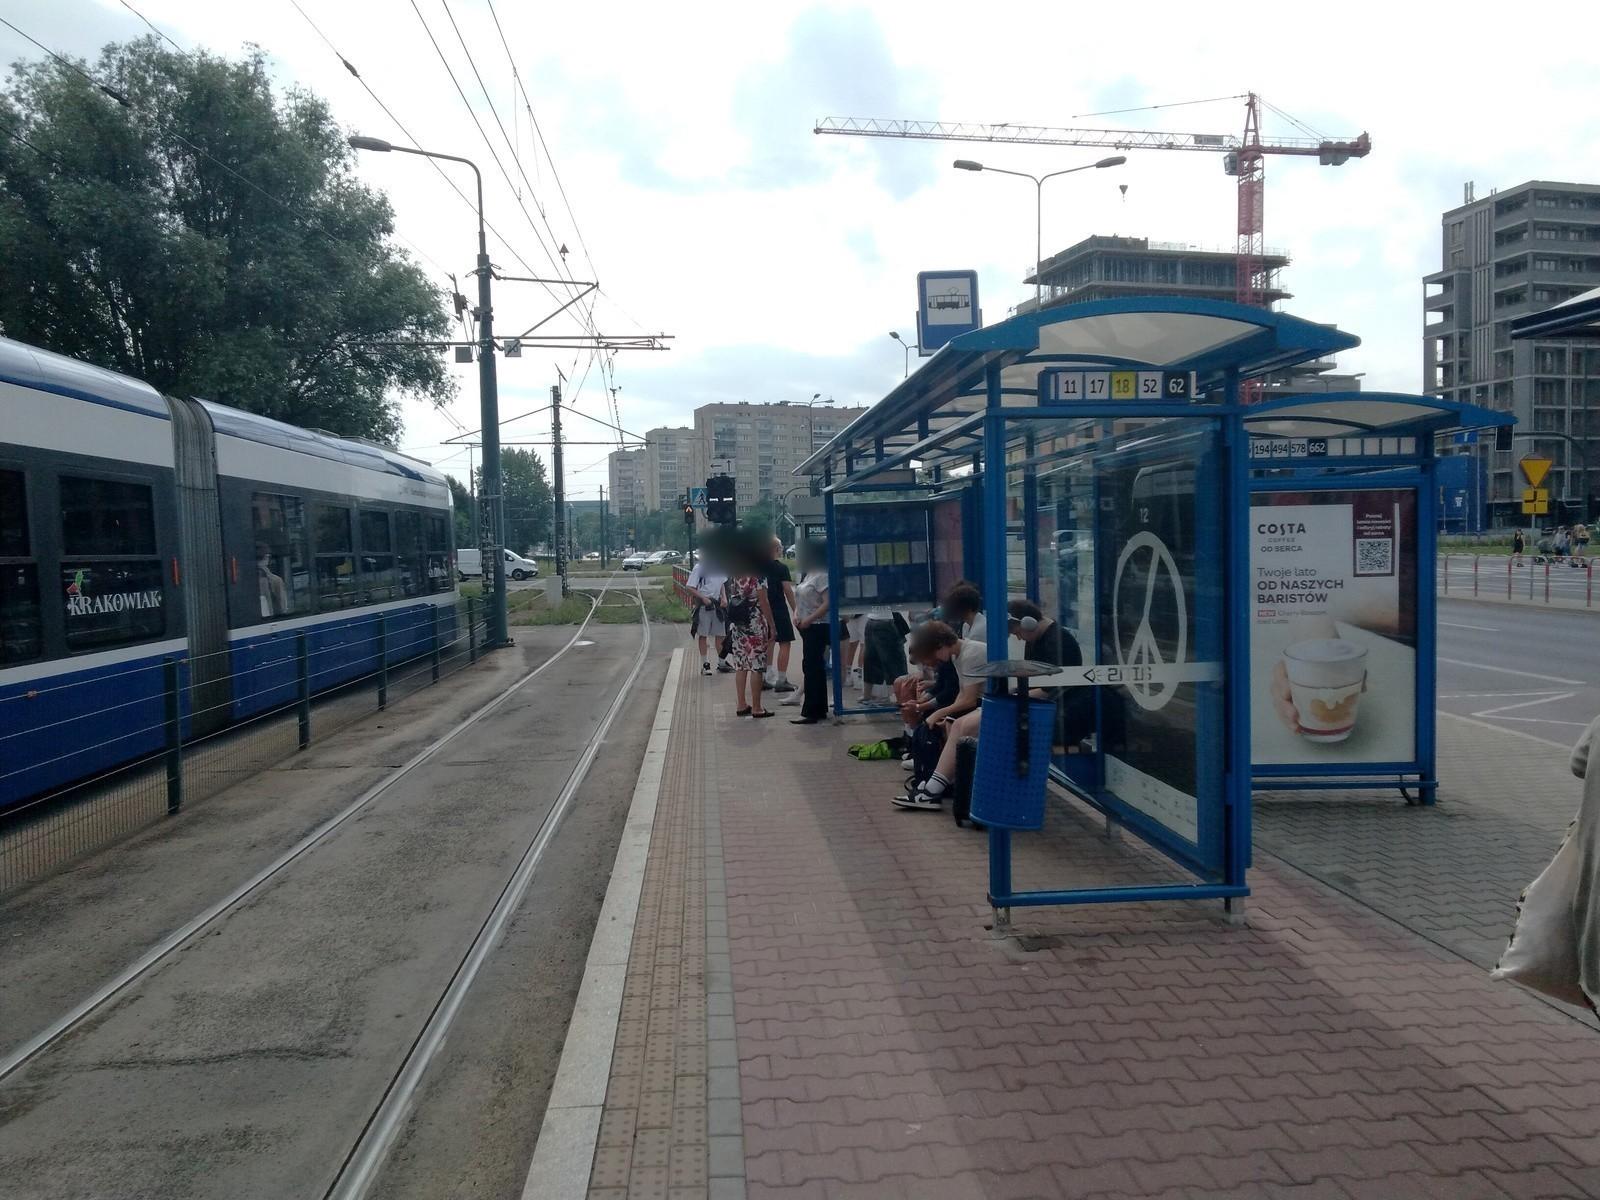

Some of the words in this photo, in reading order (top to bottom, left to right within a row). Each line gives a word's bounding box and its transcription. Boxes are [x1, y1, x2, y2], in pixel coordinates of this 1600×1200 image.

[1063, 379, 1077, 394] 11
[1090, 379, 1105, 394] 17
[1115, 379, 1130, 394] 18
[1143, 378, 1157, 393] 52
[1169, 378, 1184, 393] 62
[1254, 444, 1270, 455] 194
[1271, 443, 1288, 454] 494
[1291, 443, 1306, 454] 578
[1257, 523, 1306, 535] COSTA
[1274, 545, 1303, 553] SERCA
[1256, 567, 1292, 579] Twoje
[1294, 566, 1317, 577] lato
[1257, 580, 1278, 591] OD
[1280, 579, 1344, 590] NASZYCH
[69, 590, 161, 616] KRAKOWIAK
[1257, 590, 1328, 604] BARISTÓW
